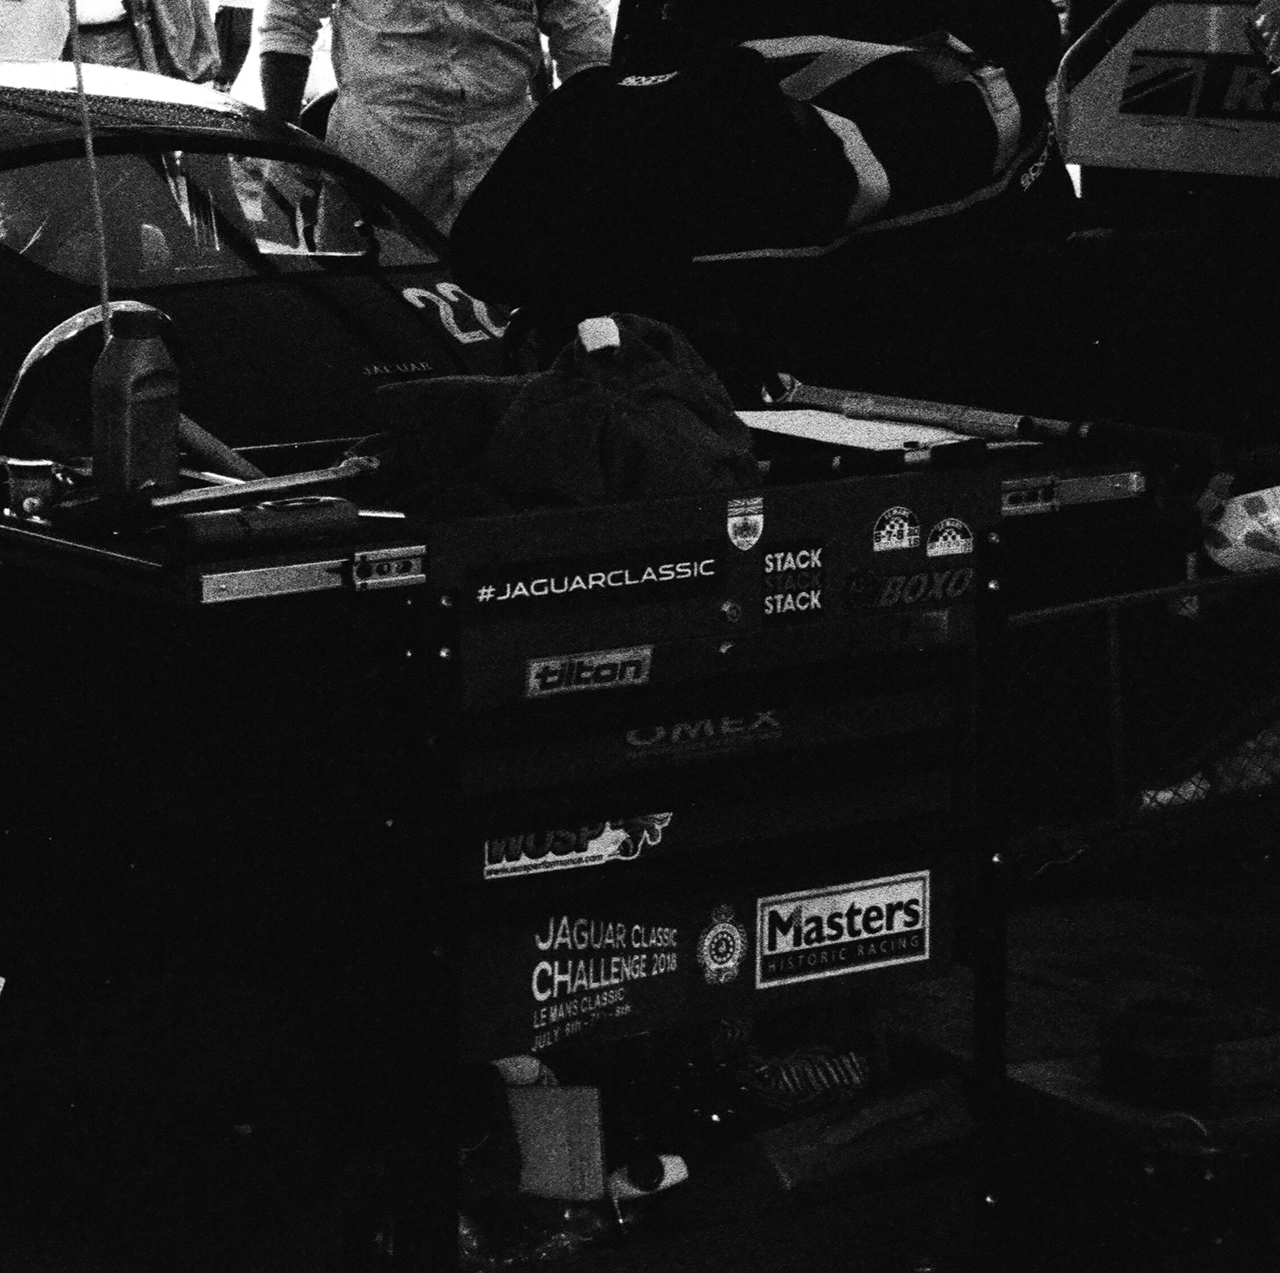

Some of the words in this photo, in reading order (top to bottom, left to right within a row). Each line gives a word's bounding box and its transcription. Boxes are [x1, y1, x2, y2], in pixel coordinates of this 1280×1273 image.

[763, 547, 823, 574] STACK
[476, 559, 716, 603] #JAGUARCLASSIC
[878, 566, 975, 607] BOXO
[763, 589, 823, 615] STACK
[536, 657, 643, 690] tilton
[625, 709, 780, 746] OMEX
[535, 915, 627, 951] JAGUAR
[631, 924, 678, 949] CLASSIC
[767, 898, 921, 952] Masters
[767, 946, 848, 974] HISTORIC
[856, 934, 920, 956] RACING
[531, 953, 647, 1002] CHALLENGE
[651, 952, 678, 976] 2018
[533, 1007, 547, 1029] LE
[549, 998, 579, 1023] MANS
[580, 987, 626, 1014] CLASSIC
[531, 1026, 561, 1052] JULY
